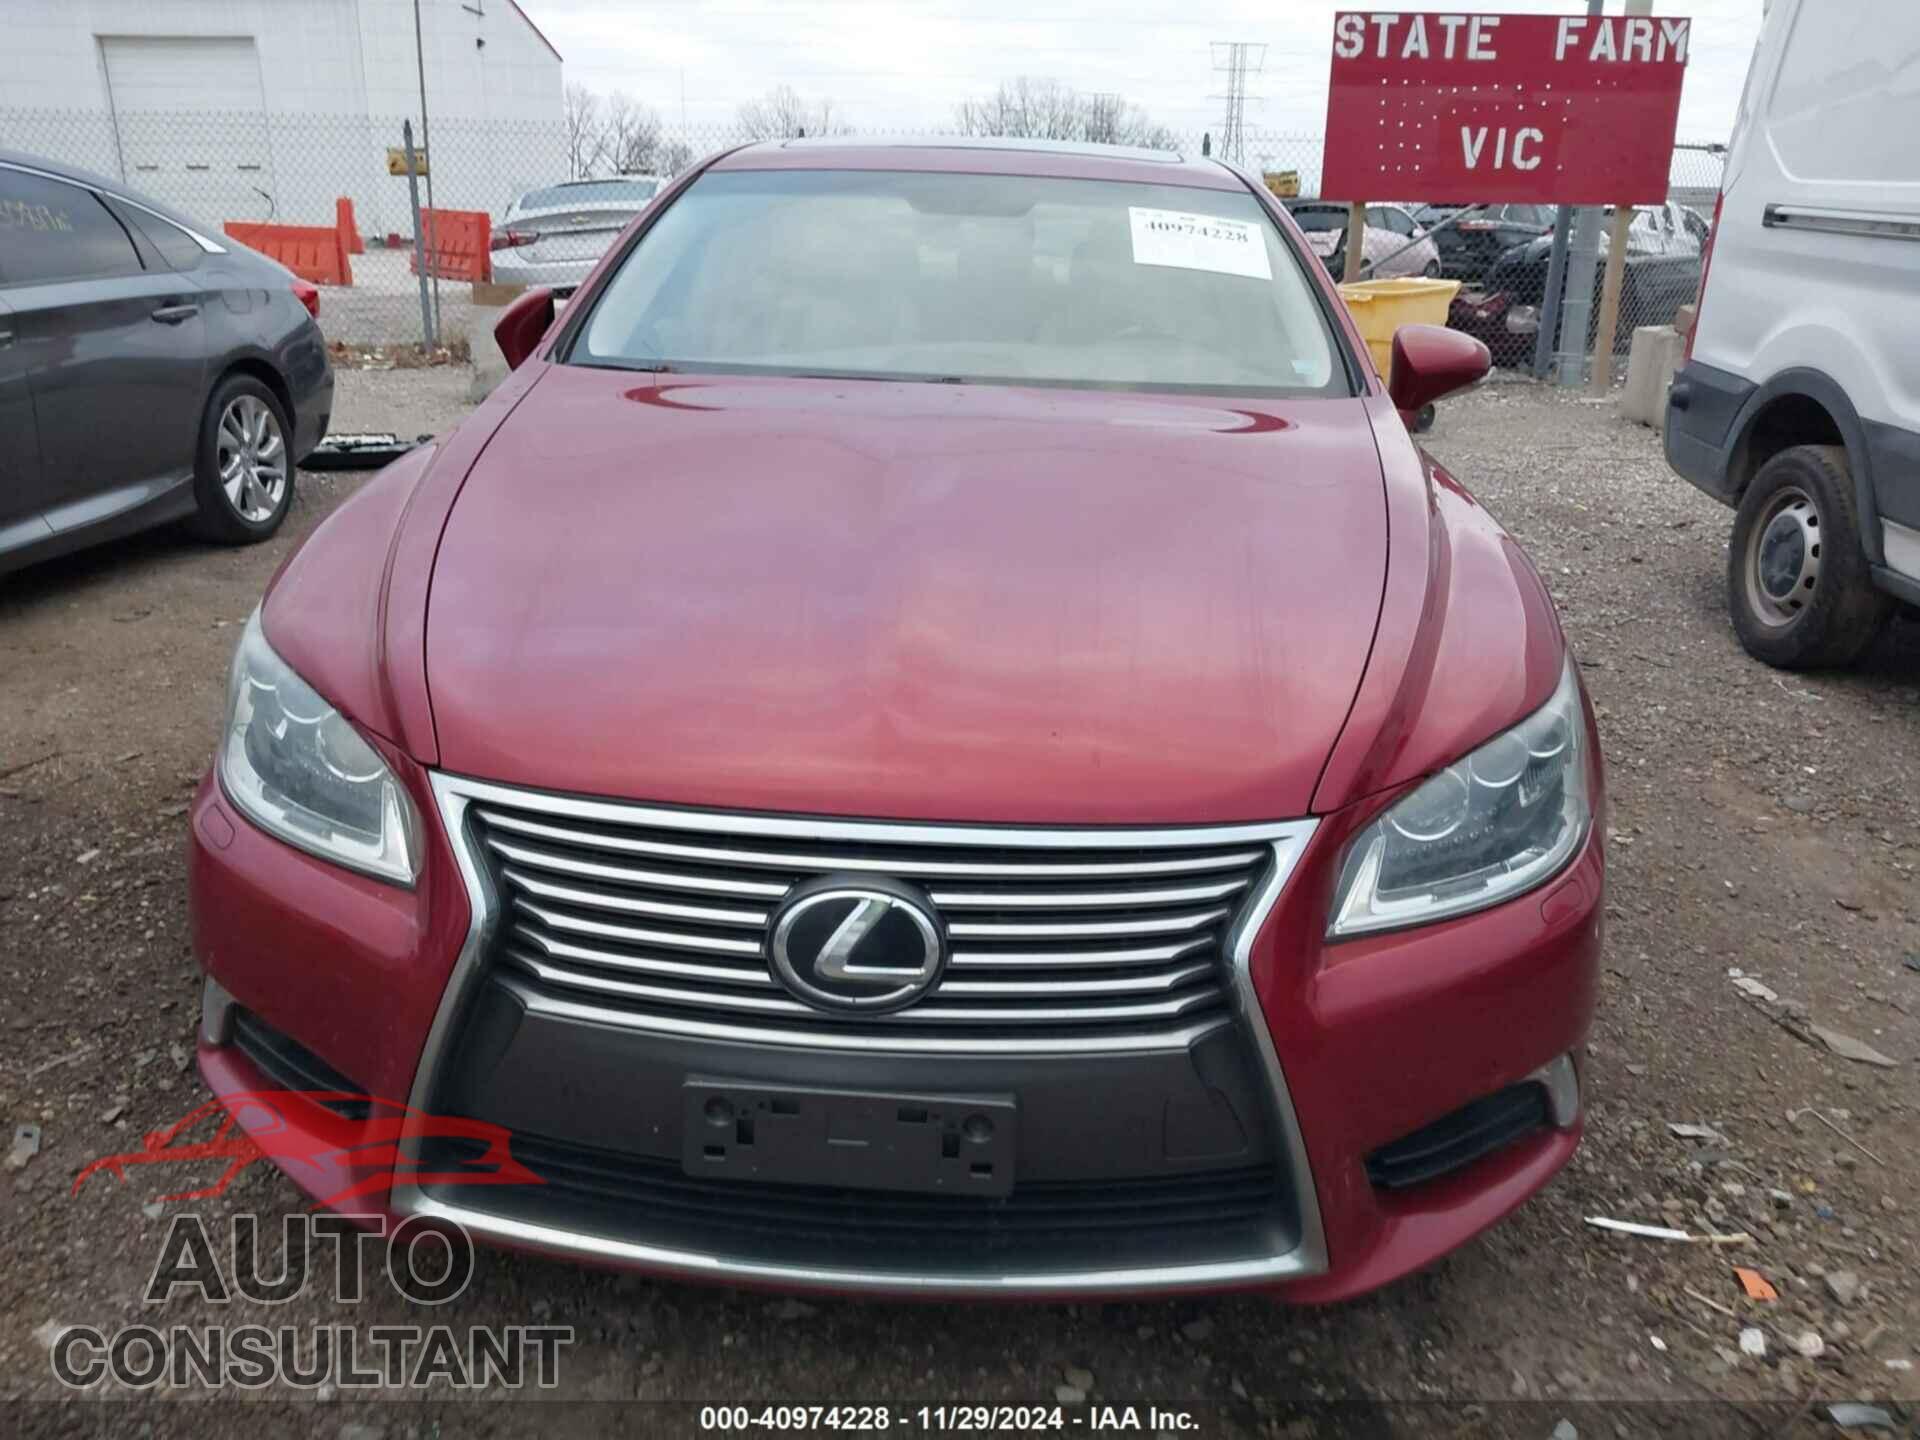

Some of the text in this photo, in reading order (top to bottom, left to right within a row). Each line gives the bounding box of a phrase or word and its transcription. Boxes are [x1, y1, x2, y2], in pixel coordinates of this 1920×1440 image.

[1335, 15, 1689, 62] STATE FARM
[1461, 126, 1544, 170] VIC
